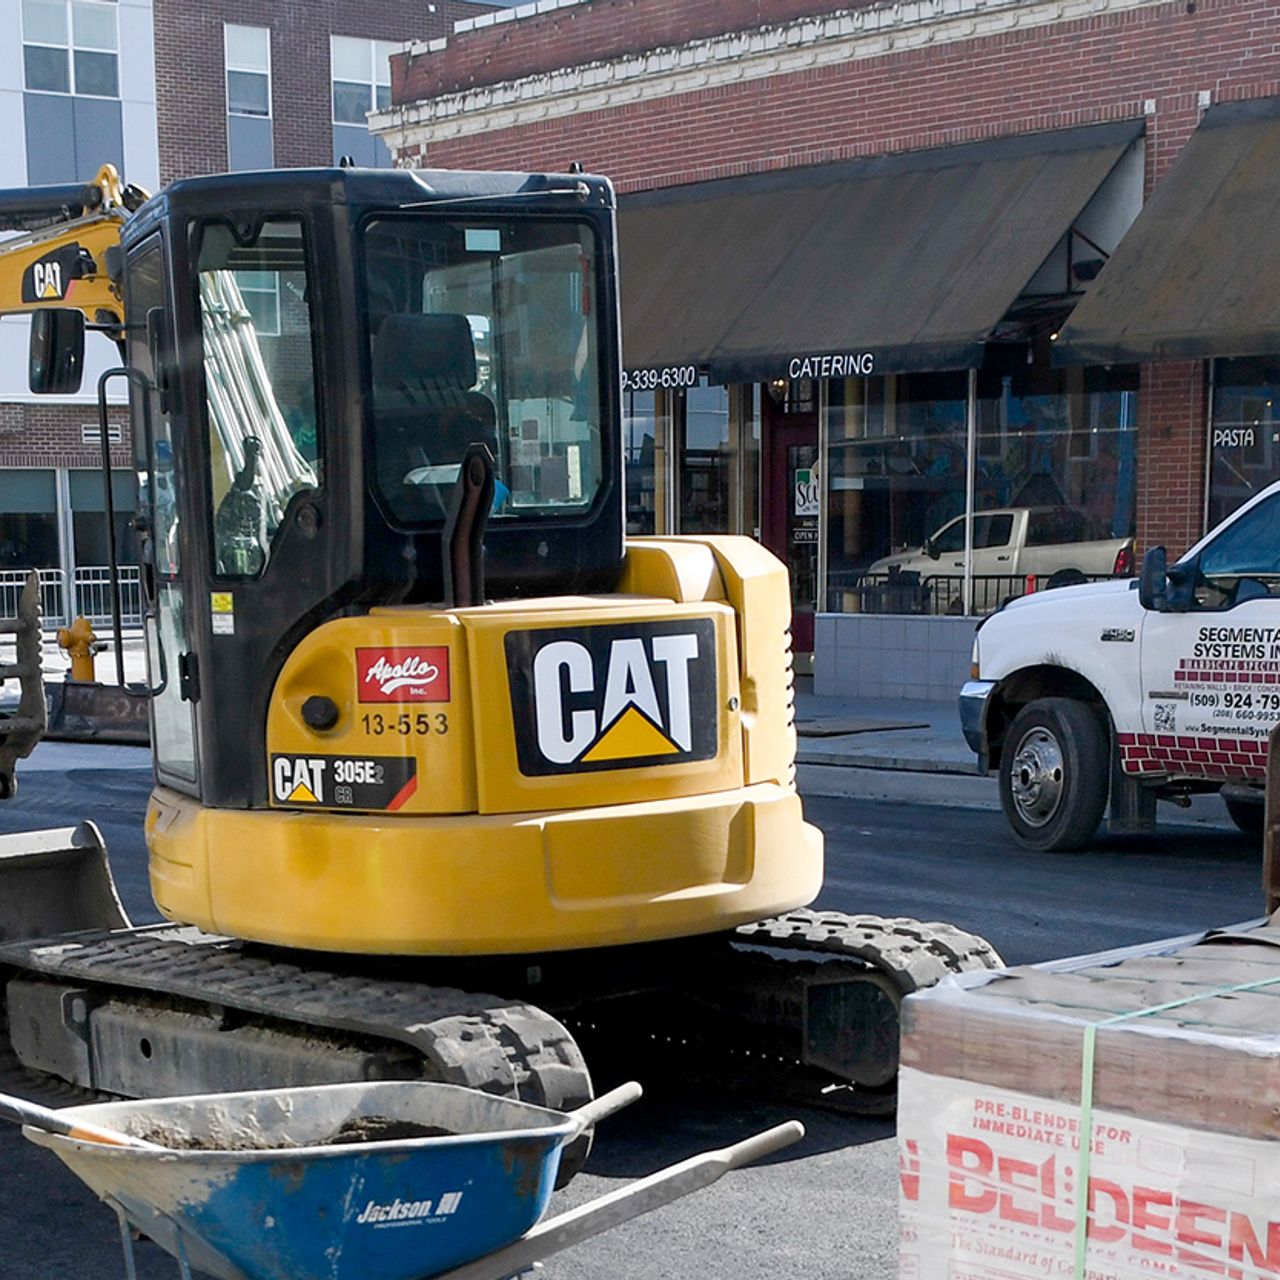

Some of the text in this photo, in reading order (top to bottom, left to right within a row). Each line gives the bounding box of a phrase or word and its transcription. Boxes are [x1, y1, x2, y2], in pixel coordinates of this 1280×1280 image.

[33, 261, 62, 299] CAT
[788, 353, 874, 379] CATERING
[1213, 429, 1255, 447] PASTA
[1193, 644, 1265, 659] SYSTEMS
[365, 656, 438, 689] Apollo
[409, 687, 428, 696] Inc.
[533, 633, 699, 764] CAT
[1190, 693, 1220, 708] (509)
[360, 713, 449, 736] 13-553
[273, 757, 327, 803] CAT
[334, 786, 353, 805] CR
[972, 1116, 1065, 1147] IMMEDIATE
[974, 1099, 1132, 1144] PRE-BLENDE FOR
[356, 1198, 433, 1224] Jackson
[950, 1232, 972, 1252] The
[975, 1239, 1038, 1266] Standard
[1041, 1256, 1054, 1275] of
